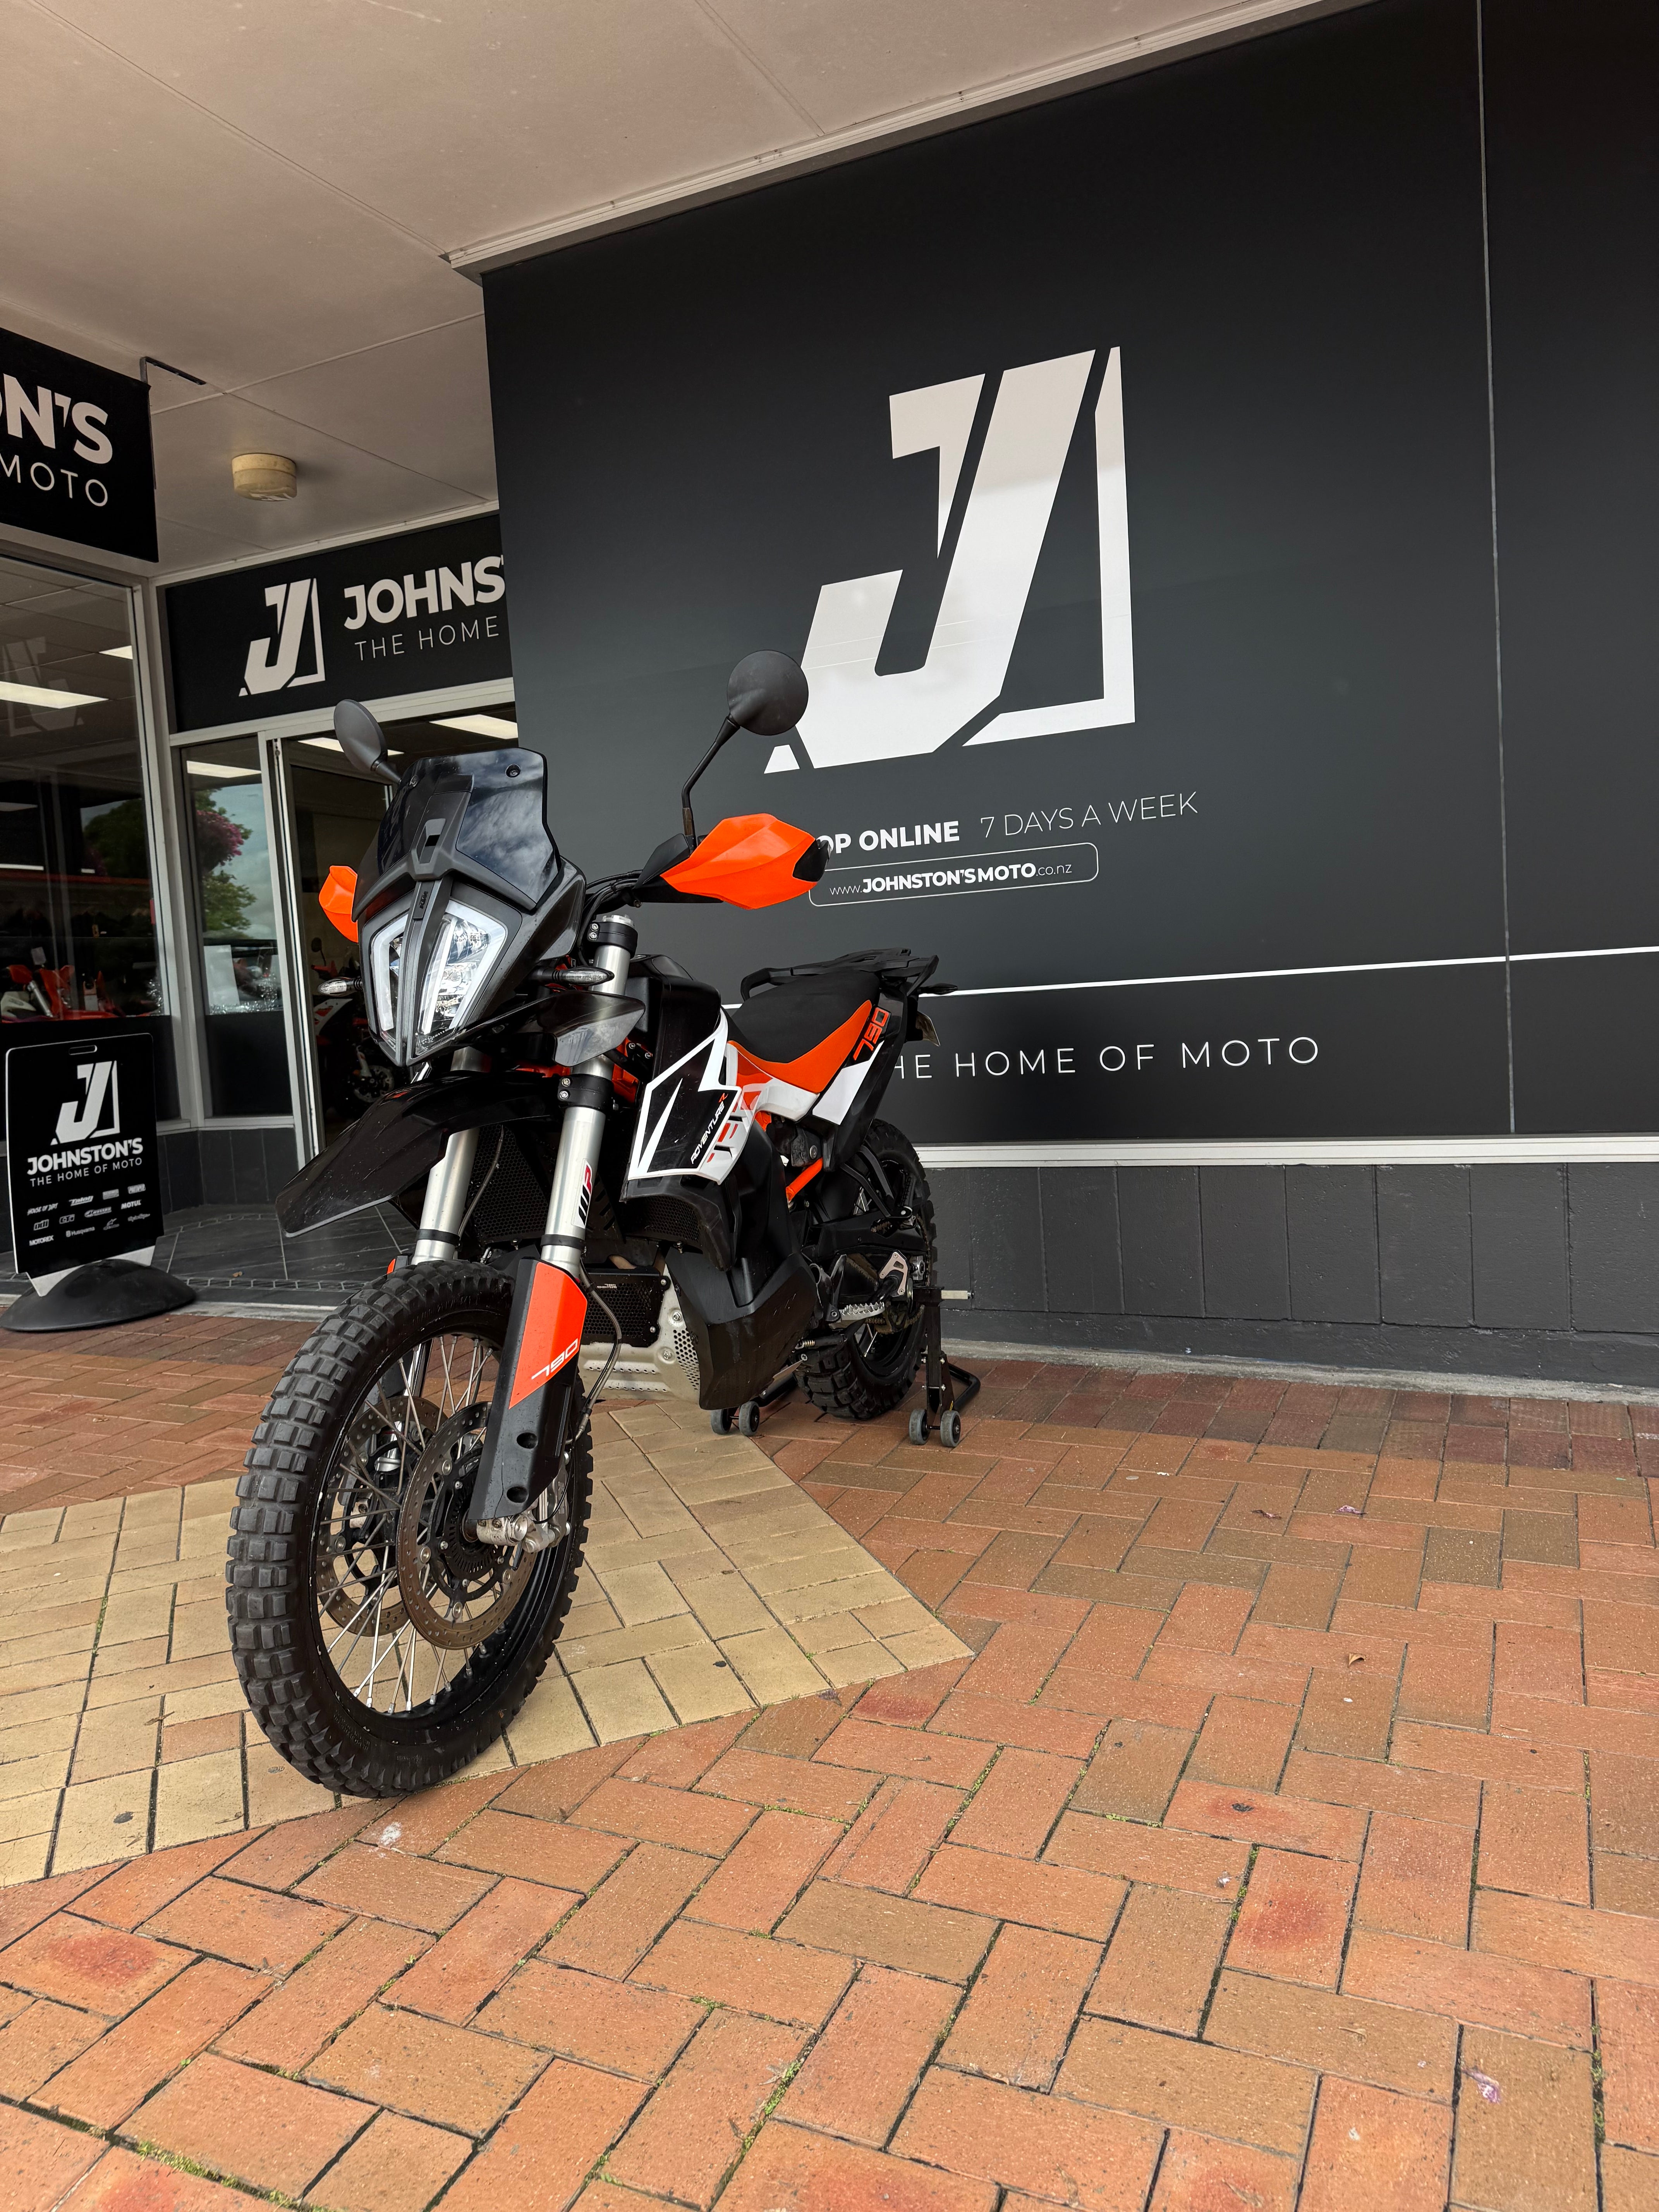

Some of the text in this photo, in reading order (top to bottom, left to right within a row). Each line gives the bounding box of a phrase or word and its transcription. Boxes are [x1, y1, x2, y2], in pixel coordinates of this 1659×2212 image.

[0, 374, 112, 464] N'S
[344, 555, 505, 629] JOHNS
[355, 616, 499, 661] THE HOME
[859, 821, 960, 851] ONLINE
[981, 816, 994, 838] 7
[1005, 807, 1074, 836] DAYS
[1081, 805, 1101, 827] A
[1108, 791, 1198, 823] WEEK
[853, 1007, 890, 1061] 790
[955, 1048, 1075, 1077] HOME
[1099, 1044, 1154, 1071] OF
[1182, 1037, 1318, 1068] MOTO
[690, 1101, 725, 1164] ADVENTURE
[27, 1137, 143, 1175] JOHNSTON'S
[29, 1157, 142, 1187] THE HOME OF MOTO
[121, 1200, 141, 1209] MOTUL
[29, 1235, 54, 1246] MOTOREX
[531, 1338, 578, 1380] 790
